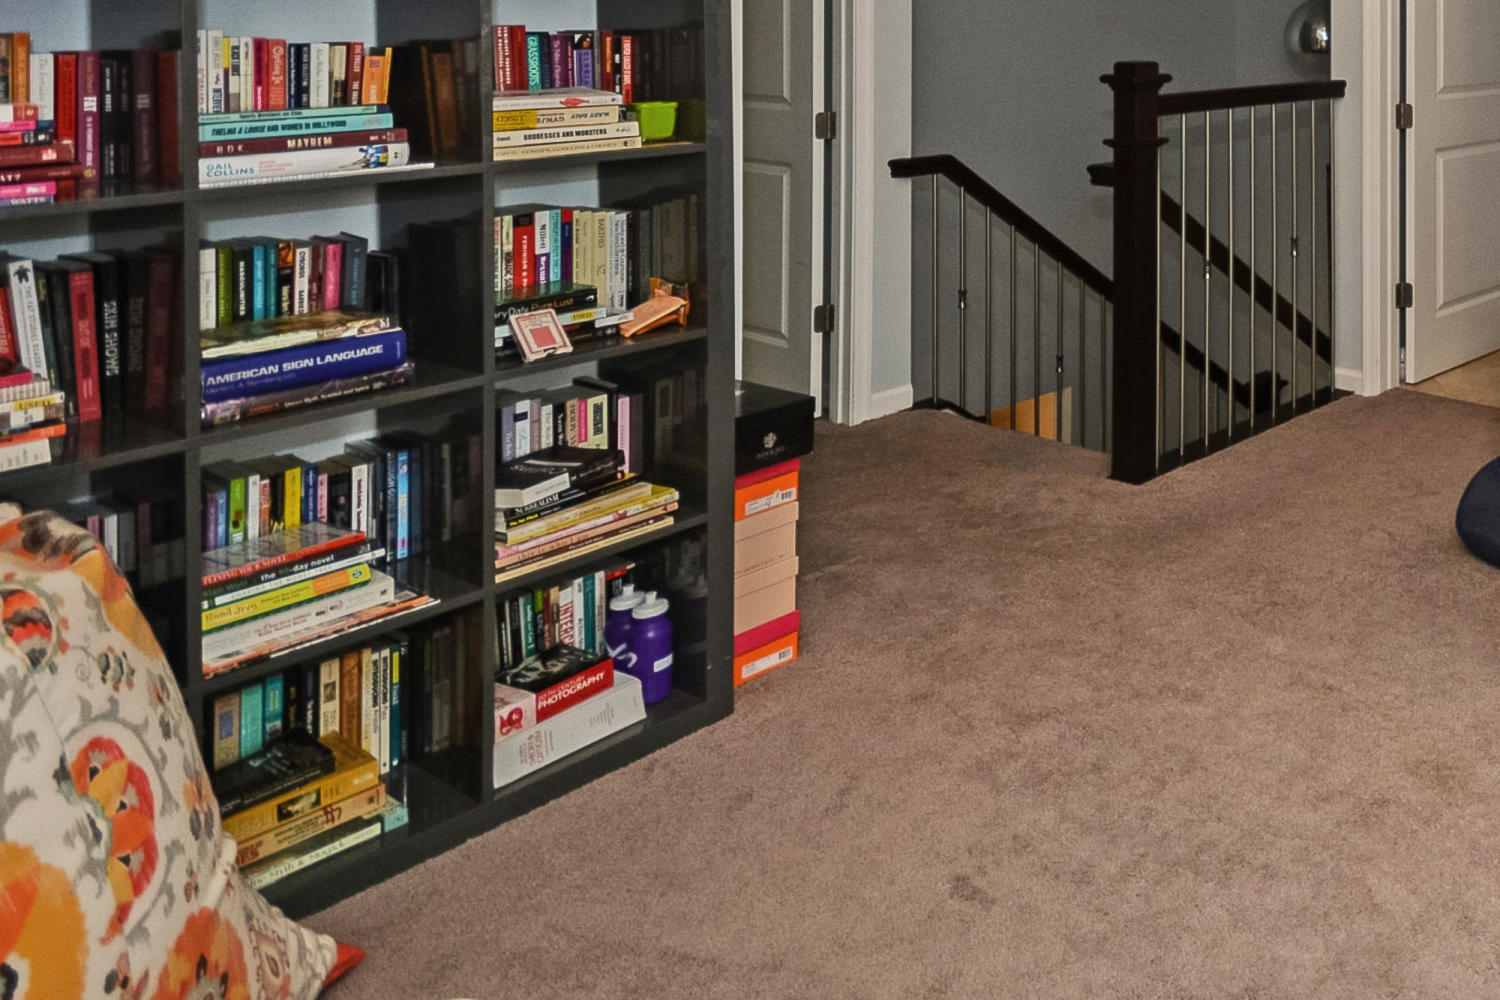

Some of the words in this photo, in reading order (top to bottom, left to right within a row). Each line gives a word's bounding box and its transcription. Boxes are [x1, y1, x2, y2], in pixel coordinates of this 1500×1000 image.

[528, 36, 539, 86] GRASSROOTS
[211, 126, 236, 136] THELMA
[245, 125, 267, 134] LOUISE
[281, 122, 303, 132] WOMEN
[311, 119, 347, 130] HOLLYWOOD
[524, 131, 560, 141] GODDESSES
[562, 130, 574, 139] AND
[575, 128, 608, 138] MONSTERS
[287, 136, 333, 148] MAYHEM
[206, 162, 233, 172] GAIL
[206, 167, 255, 178] COLLINS
[105, 330, 120, 377] SHOWS
[206, 364, 279, 387] AMERICAN
[282, 356, 315, 372] SIGN
[316, 344, 384, 366] LANGUAGE
[260, 571, 276, 582] the
[310, 553, 335, 569] novel
[537, 671, 605, 710] PHOTOGRAPHY
